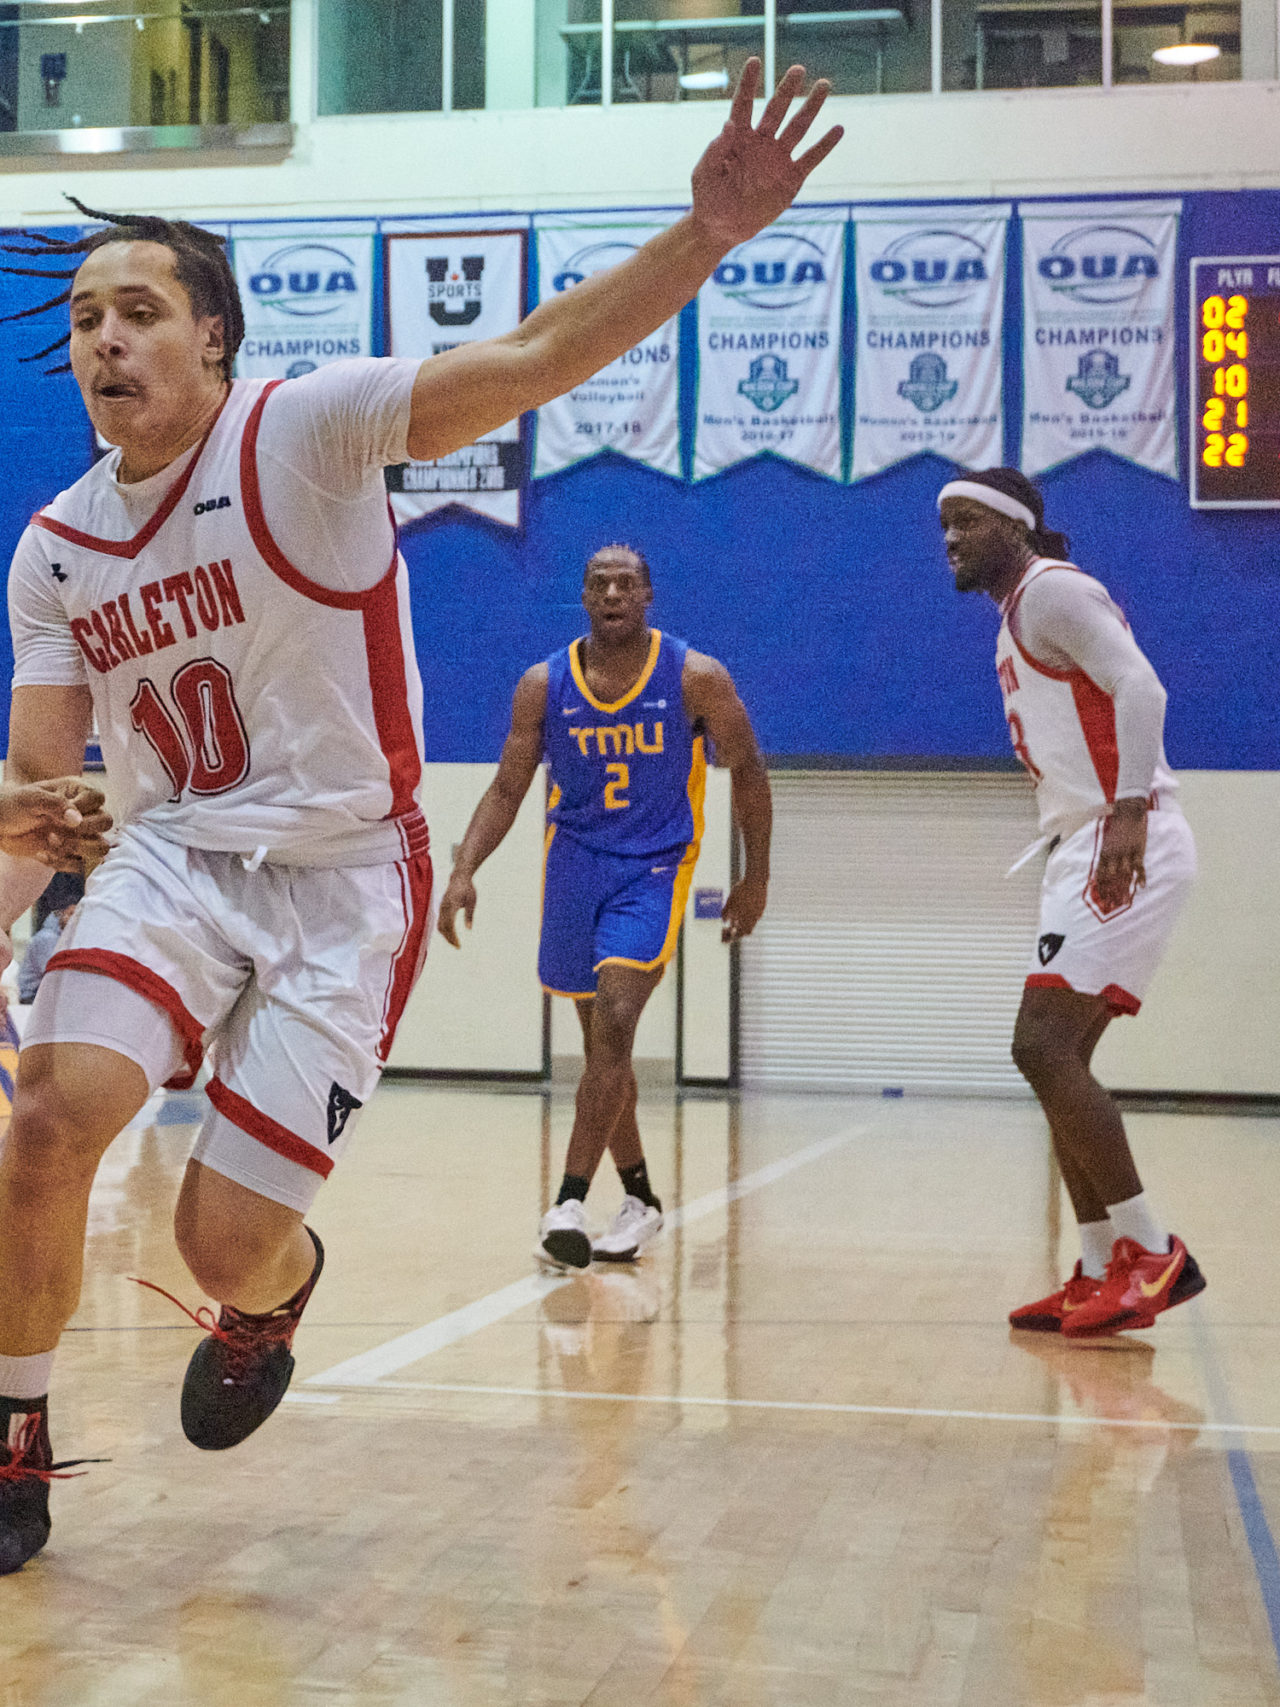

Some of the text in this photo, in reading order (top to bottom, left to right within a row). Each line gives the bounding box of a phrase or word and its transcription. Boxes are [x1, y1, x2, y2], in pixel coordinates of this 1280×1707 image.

[712, 261, 827, 286] OUA
[870, 259, 988, 283] OUA
[1038, 255, 1160, 280] OUA
[1218, 267, 1254, 288] PLYR
[249, 271, 358, 295] OUA
[428, 282, 482, 298] SPORTS
[1203, 295, 1249, 329] 02
[245, 338, 361, 357] CHAMPIONS
[708, 331, 829, 350] CHAMPIONS
[866, 329, 991, 349] CHAMPIONS
[1035, 326, 1163, 346] CHAMPIONS
[1203, 329, 1249, 363] 04
[1213, 363, 1249, 398] 10
[1202, 397, 1249, 432] 21
[1202, 432, 1249, 468] 22
[129, 656, 251, 803] 10
[569, 721, 665, 756] TMU
[604, 762, 630, 810] 2
